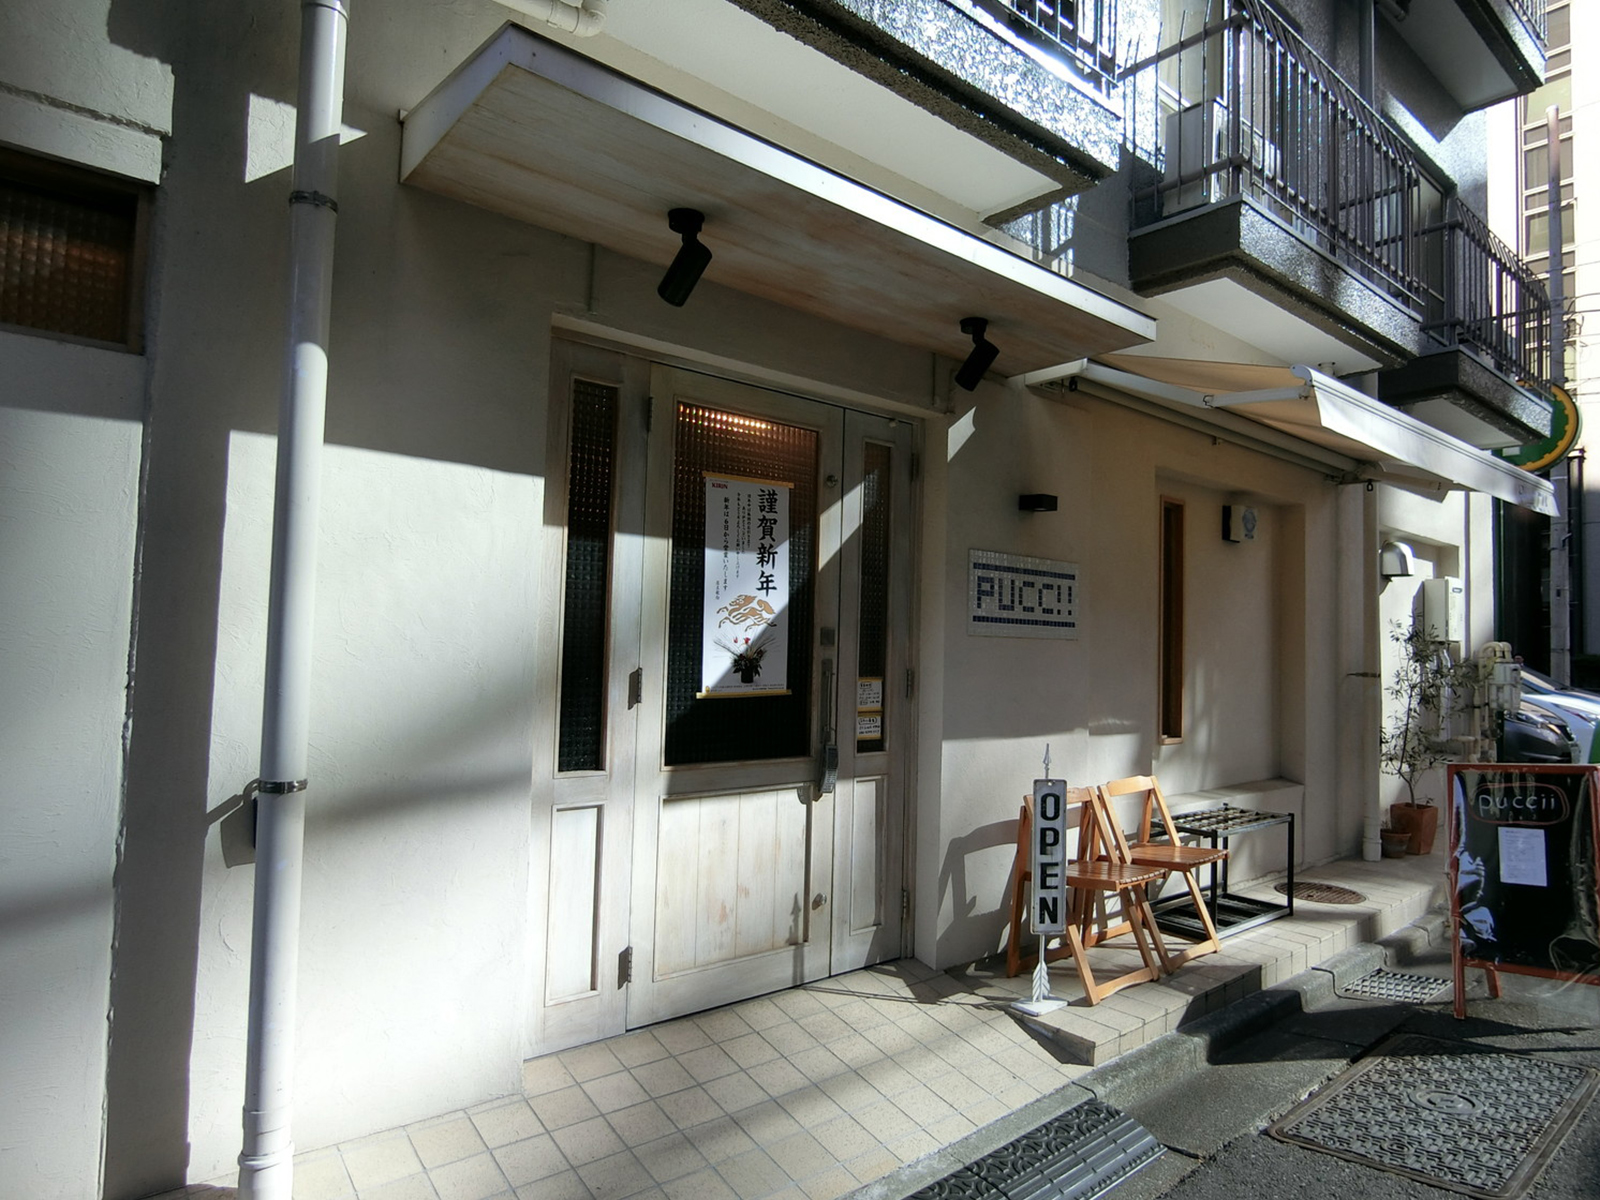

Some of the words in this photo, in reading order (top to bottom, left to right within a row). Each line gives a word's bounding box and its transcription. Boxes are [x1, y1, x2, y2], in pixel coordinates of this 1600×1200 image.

[755, 488, 778, 598] 謹賀新年
[1039, 793, 1060, 924] OPEN
